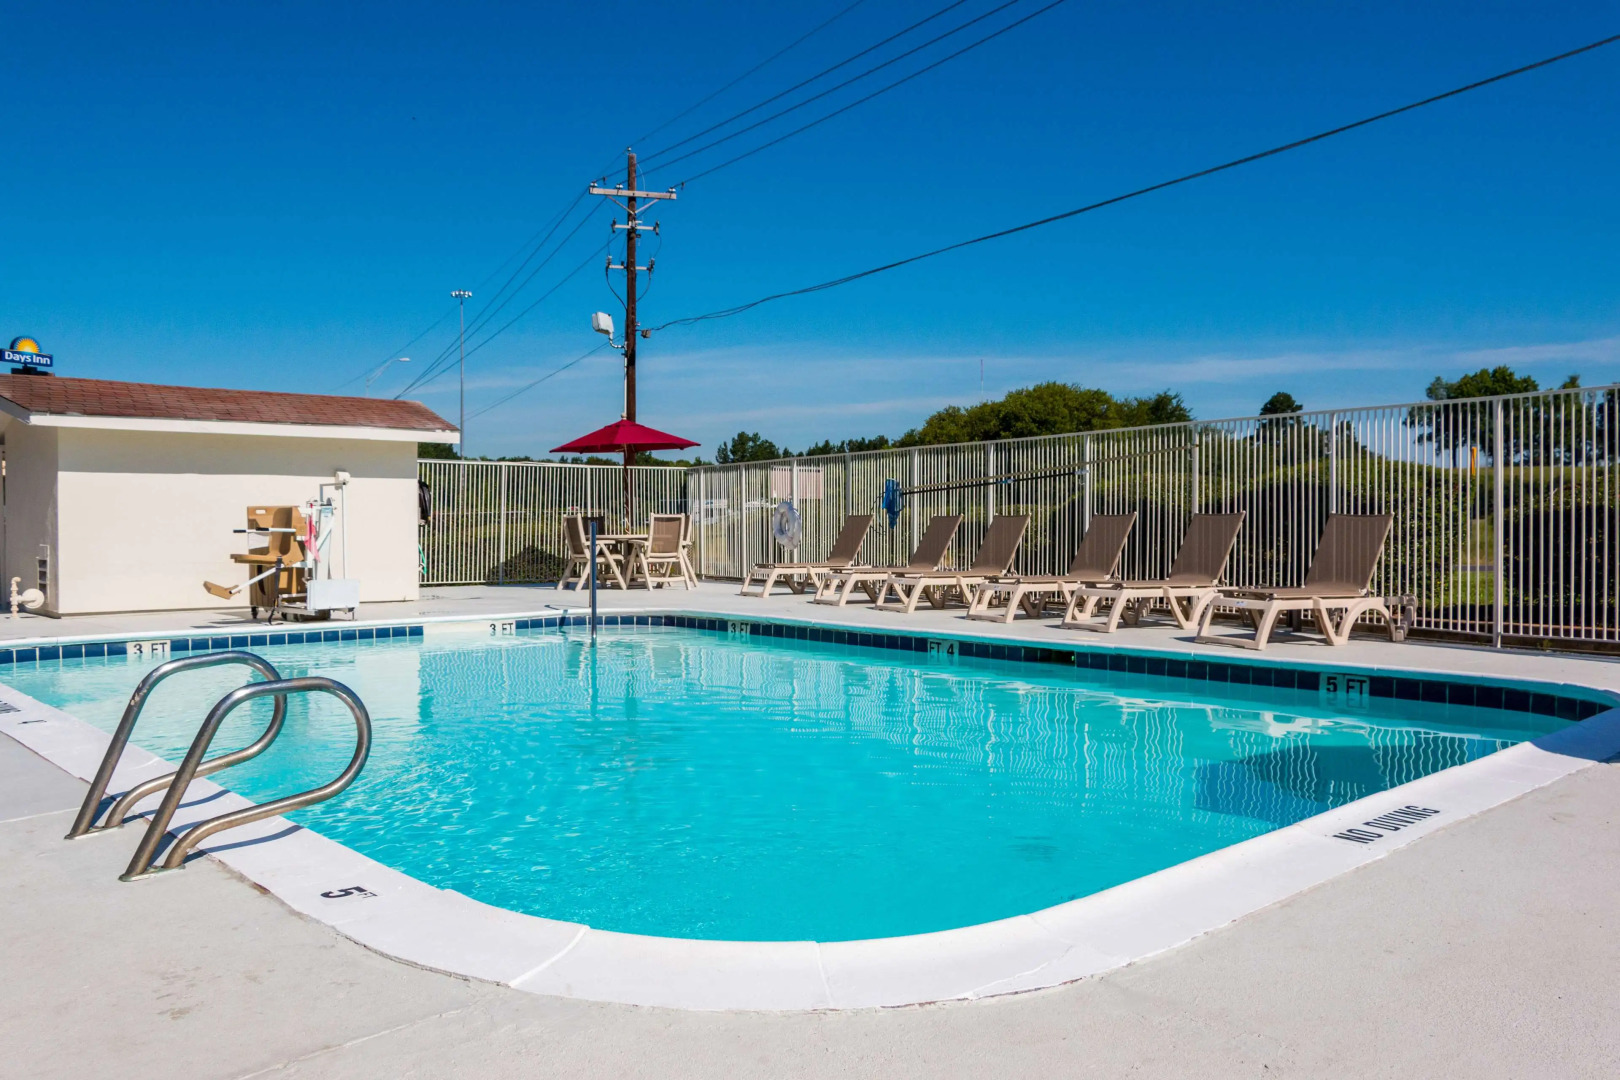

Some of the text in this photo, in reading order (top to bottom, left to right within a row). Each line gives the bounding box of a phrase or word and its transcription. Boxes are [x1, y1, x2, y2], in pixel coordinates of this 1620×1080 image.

[4, 351, 51, 365] Days Inn
[489, 622, 497, 632] 3
[730, 622, 749, 634] 3 FT
[133, 642, 168, 654] 3 FT
[930, 641, 955, 655] FT 4
[1326, 676, 1367, 695] 5 FT
[1332, 805, 1440, 844] NO DIVING
[320, 885, 368, 898] 5
